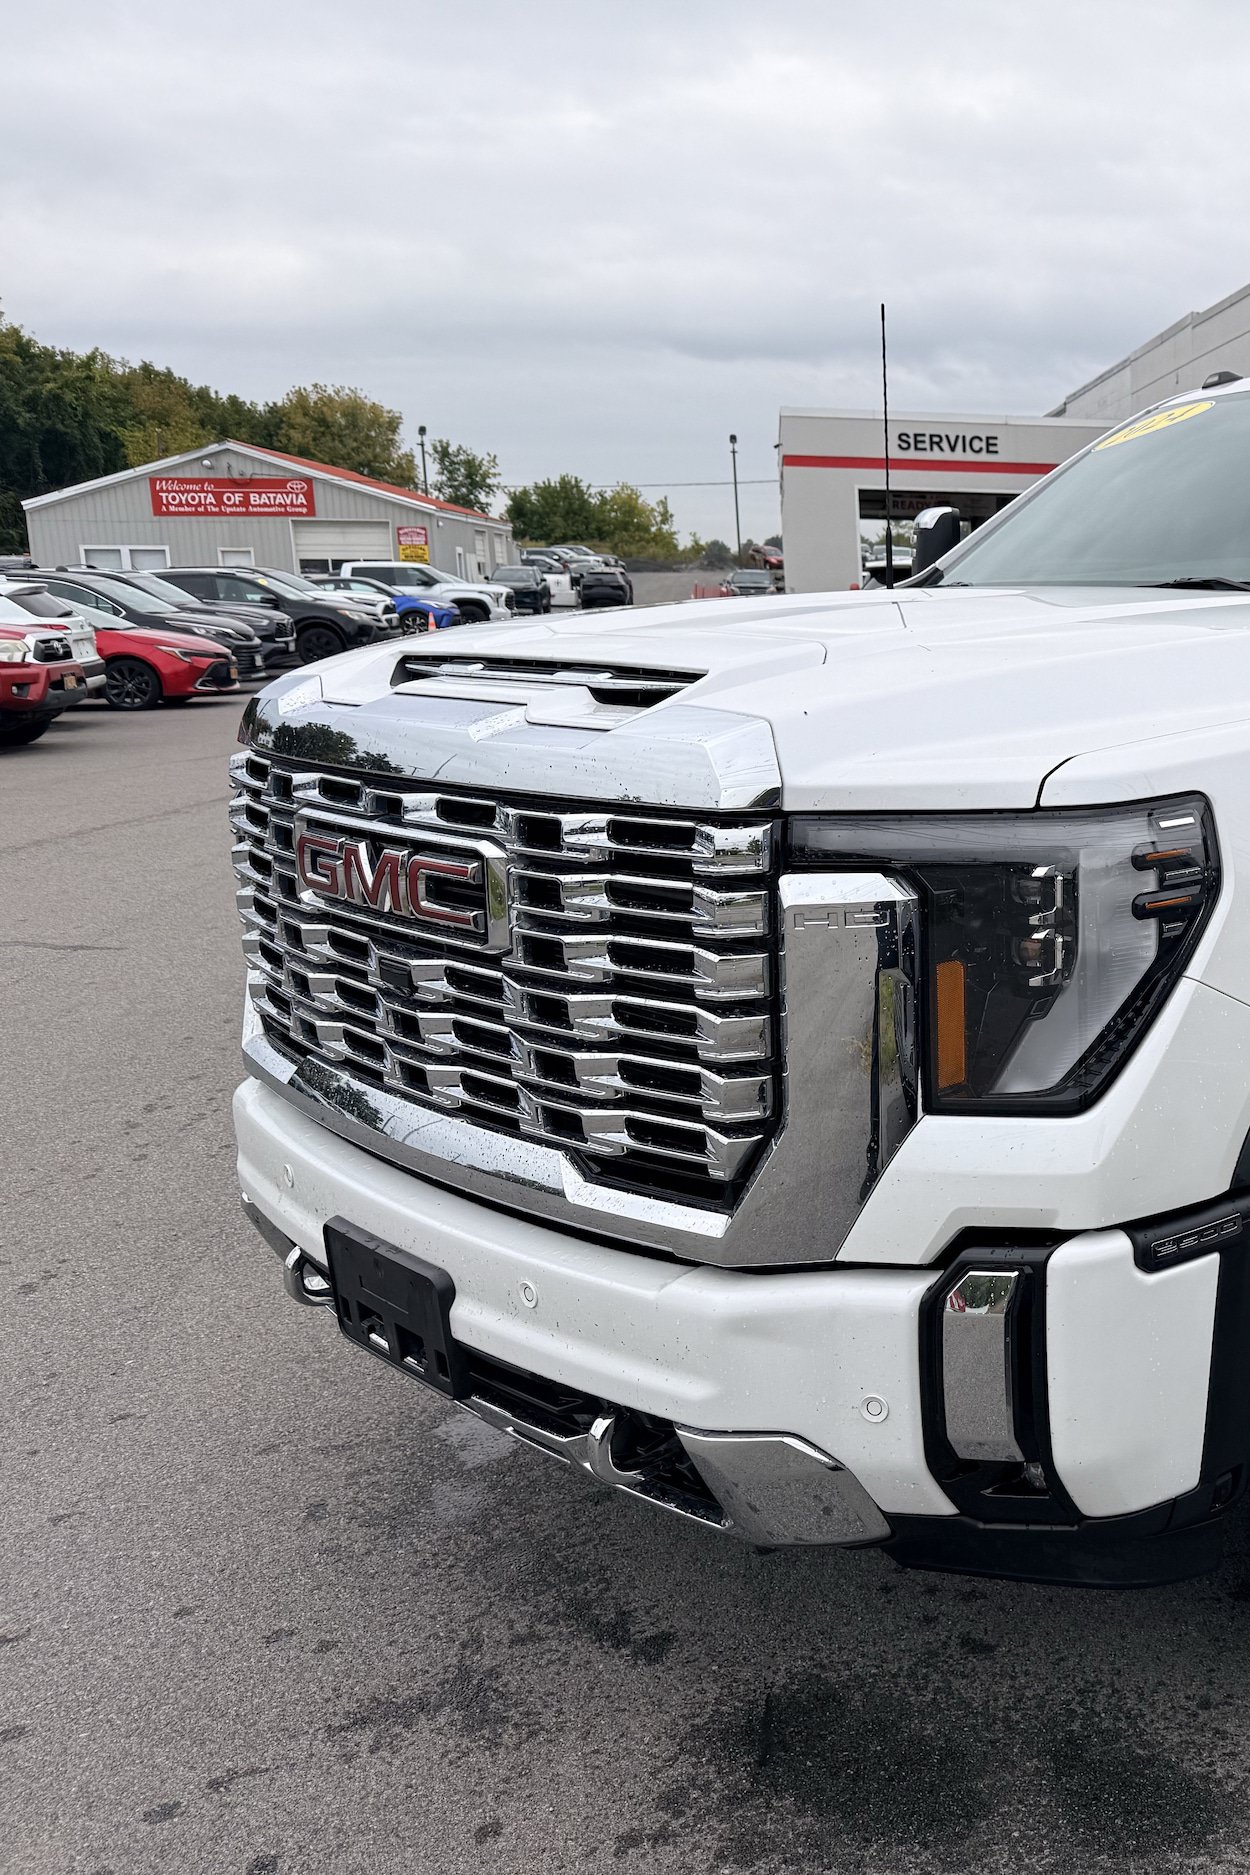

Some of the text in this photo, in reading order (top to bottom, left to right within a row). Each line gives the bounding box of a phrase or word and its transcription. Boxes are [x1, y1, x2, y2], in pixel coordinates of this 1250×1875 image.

[897, 432, 999, 455] SERVICE
[155, 480, 214, 491] Welcome to
[158, 492, 308, 505] TOYOTA OF BATAVIA
[221, 505, 246, 514] Upstate
[248, 505, 285, 513] Automotive
[286, 505, 308, 514] Group
[299, 830, 482, 932] GMC
[793, 909, 890, 931] HD
